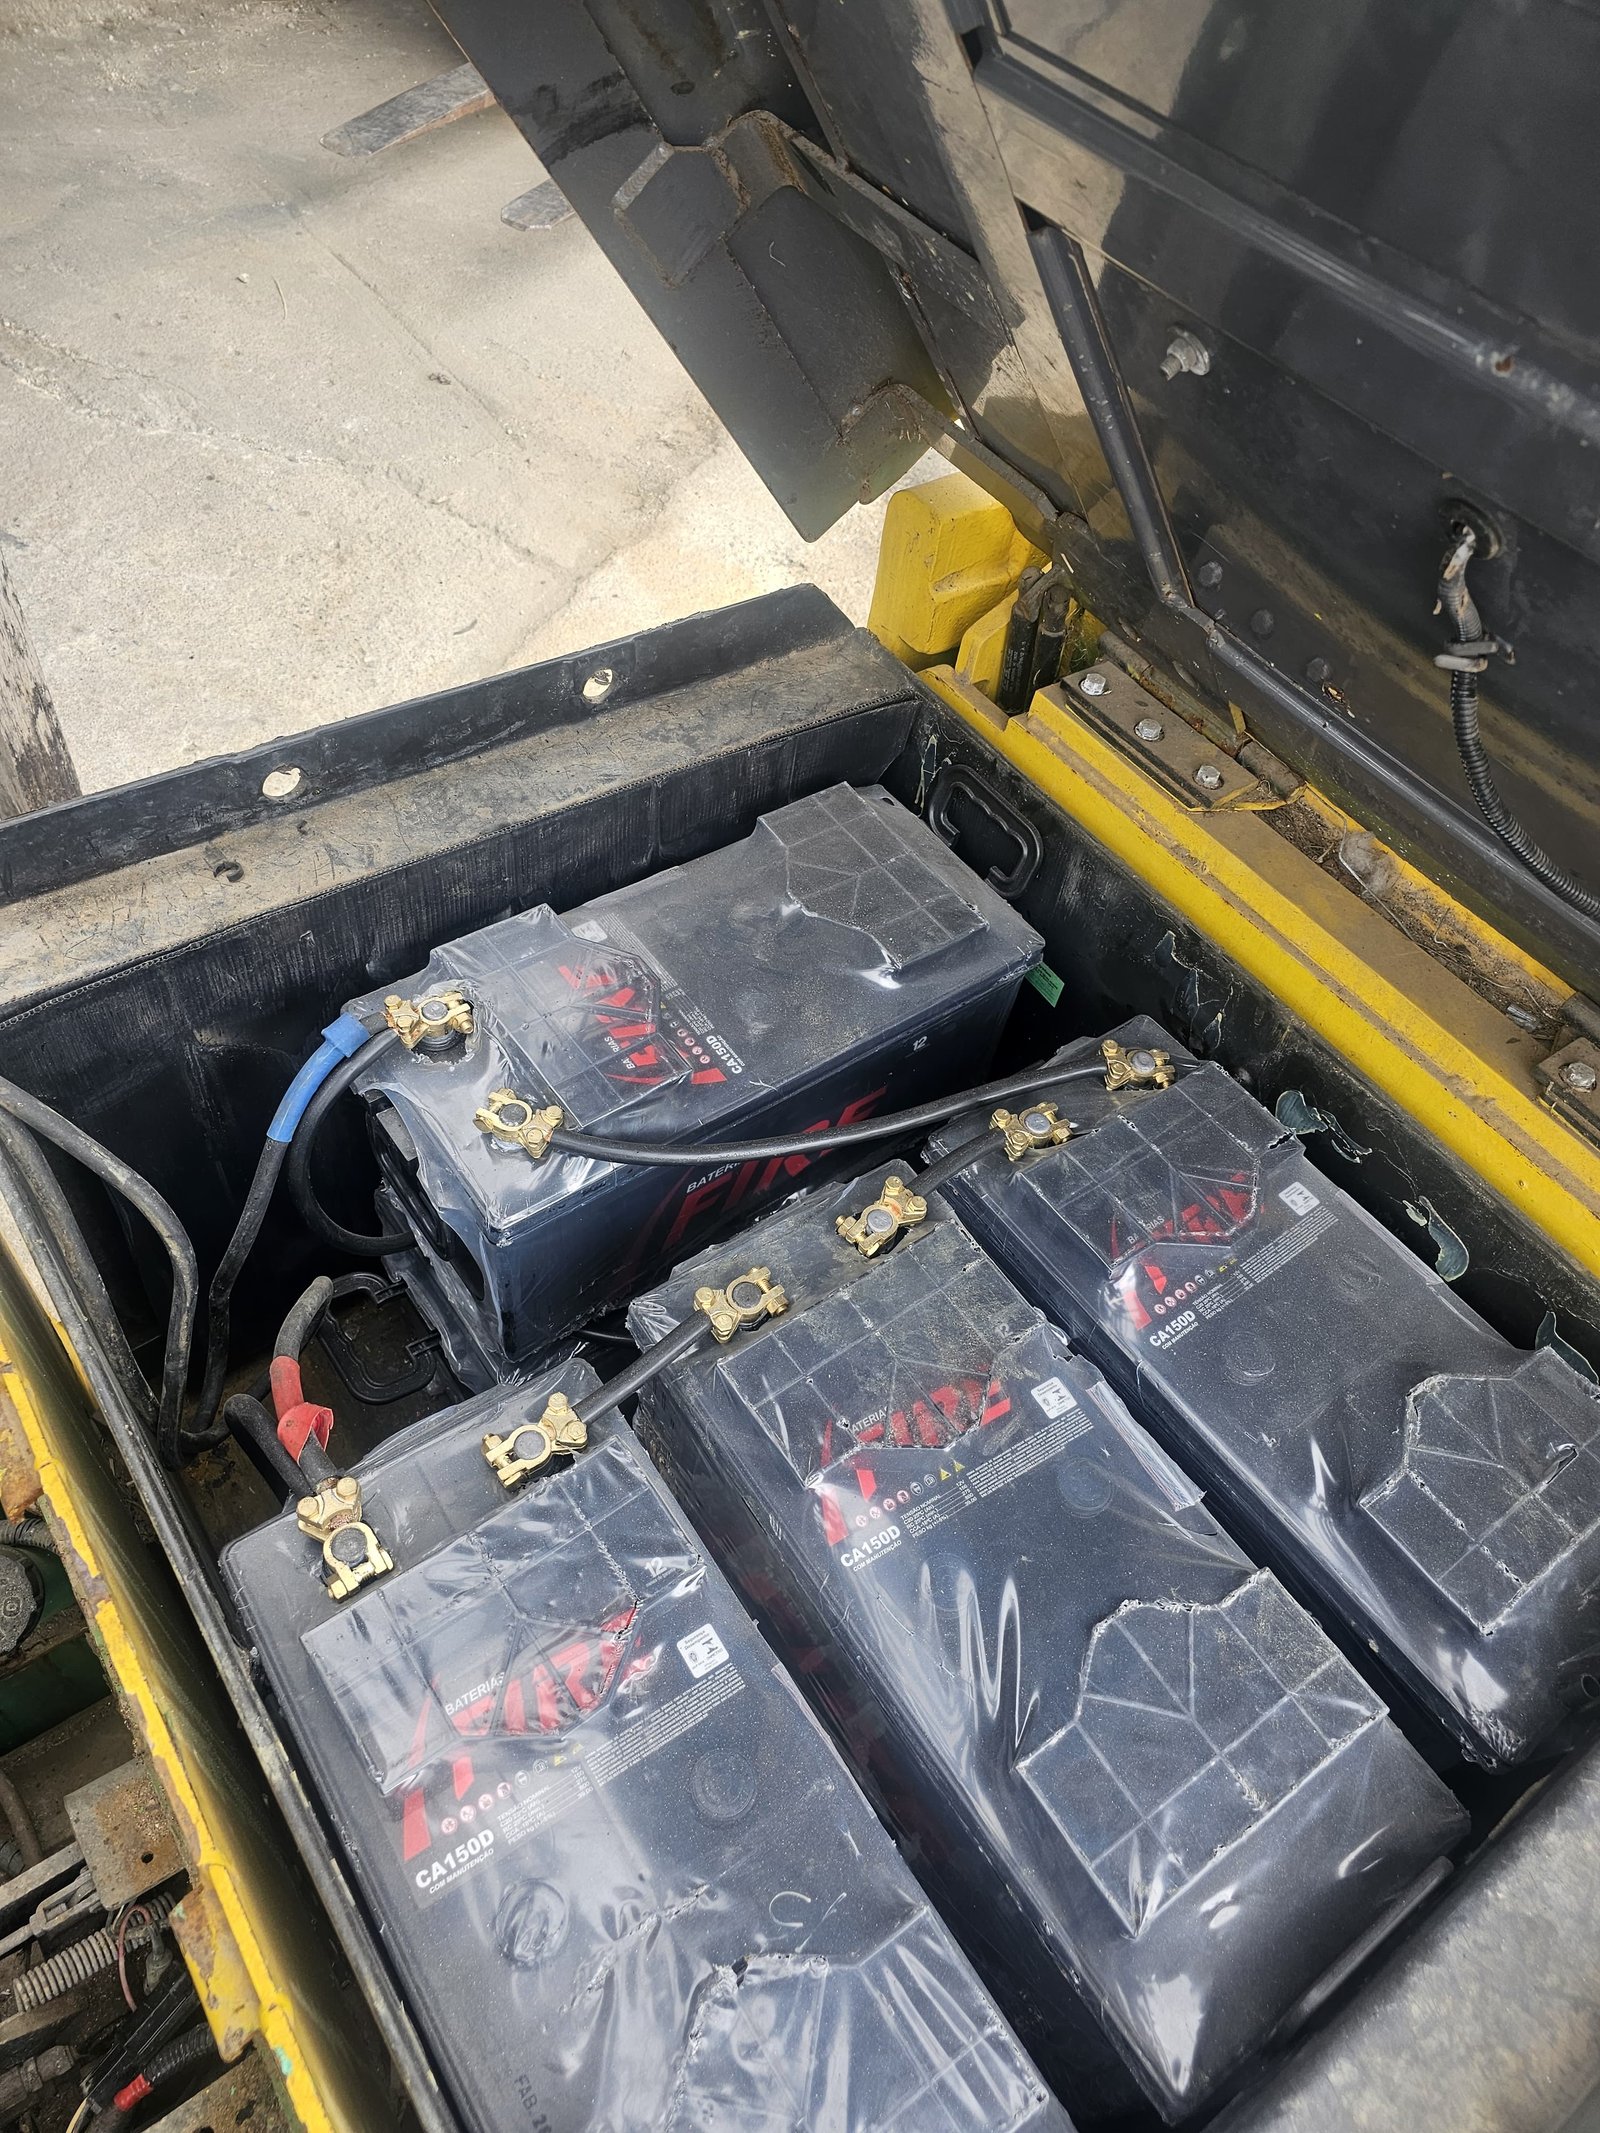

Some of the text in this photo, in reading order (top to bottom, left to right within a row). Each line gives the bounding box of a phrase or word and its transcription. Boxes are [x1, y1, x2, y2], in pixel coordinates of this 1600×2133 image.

[604, 1036, 636, 1070] BARIAS
[706, 1035, 743, 1075] CA150D
[912, 1036, 928, 1051] 12
[1127, 1215, 1165, 1243] BARIAS
[1149, 1310, 1196, 1347] CA150D
[1162, 1340, 1171, 1349] COM
[851, 1406, 889, 1433] ATERIA
[840, 1525, 901, 1567] CA150D
[853, 1539, 901, 1571] COM MANUTENÇÃO
[645, 1557, 667, 1578] 12
[415, 1829, 494, 1888] CA150D
[429, 1847, 494, 1893] COM MANUTENÇÃO
